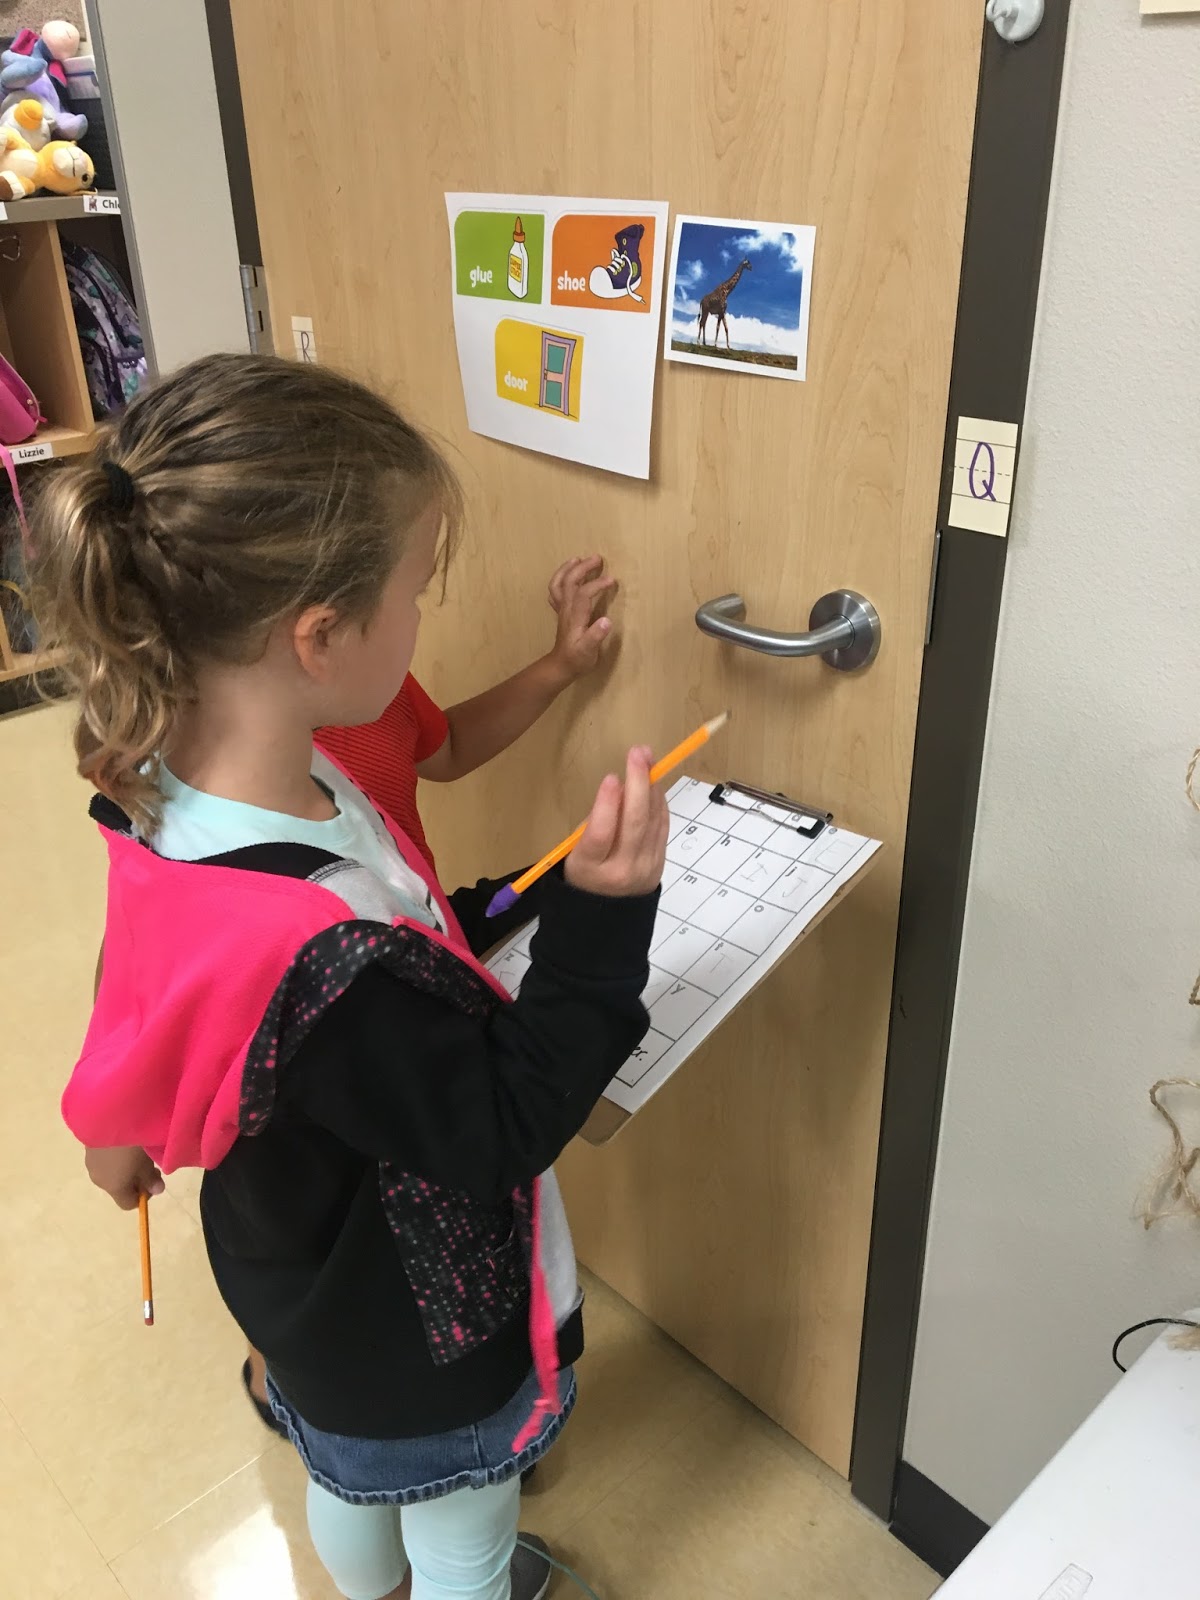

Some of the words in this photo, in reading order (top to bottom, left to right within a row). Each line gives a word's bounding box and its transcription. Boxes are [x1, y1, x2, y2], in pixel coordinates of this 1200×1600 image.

[469, 265, 493, 288] glue
[557, 270, 586, 292] shoe
[300, 331, 312, 363] R
[504, 370, 528, 392] door
[18, 447, 45, 459] Lizzie
[968, 441, 996, 501] Q
[685, 825, 698, 836] g
[720, 834, 731, 847] h
[785, 866, 797, 877] j
[684, 874, 697, 885] m
[717, 889, 728, 898] n
[754, 904, 765, 913] o
[678, 927, 689, 935] s
[670, 984, 686, 995] y
